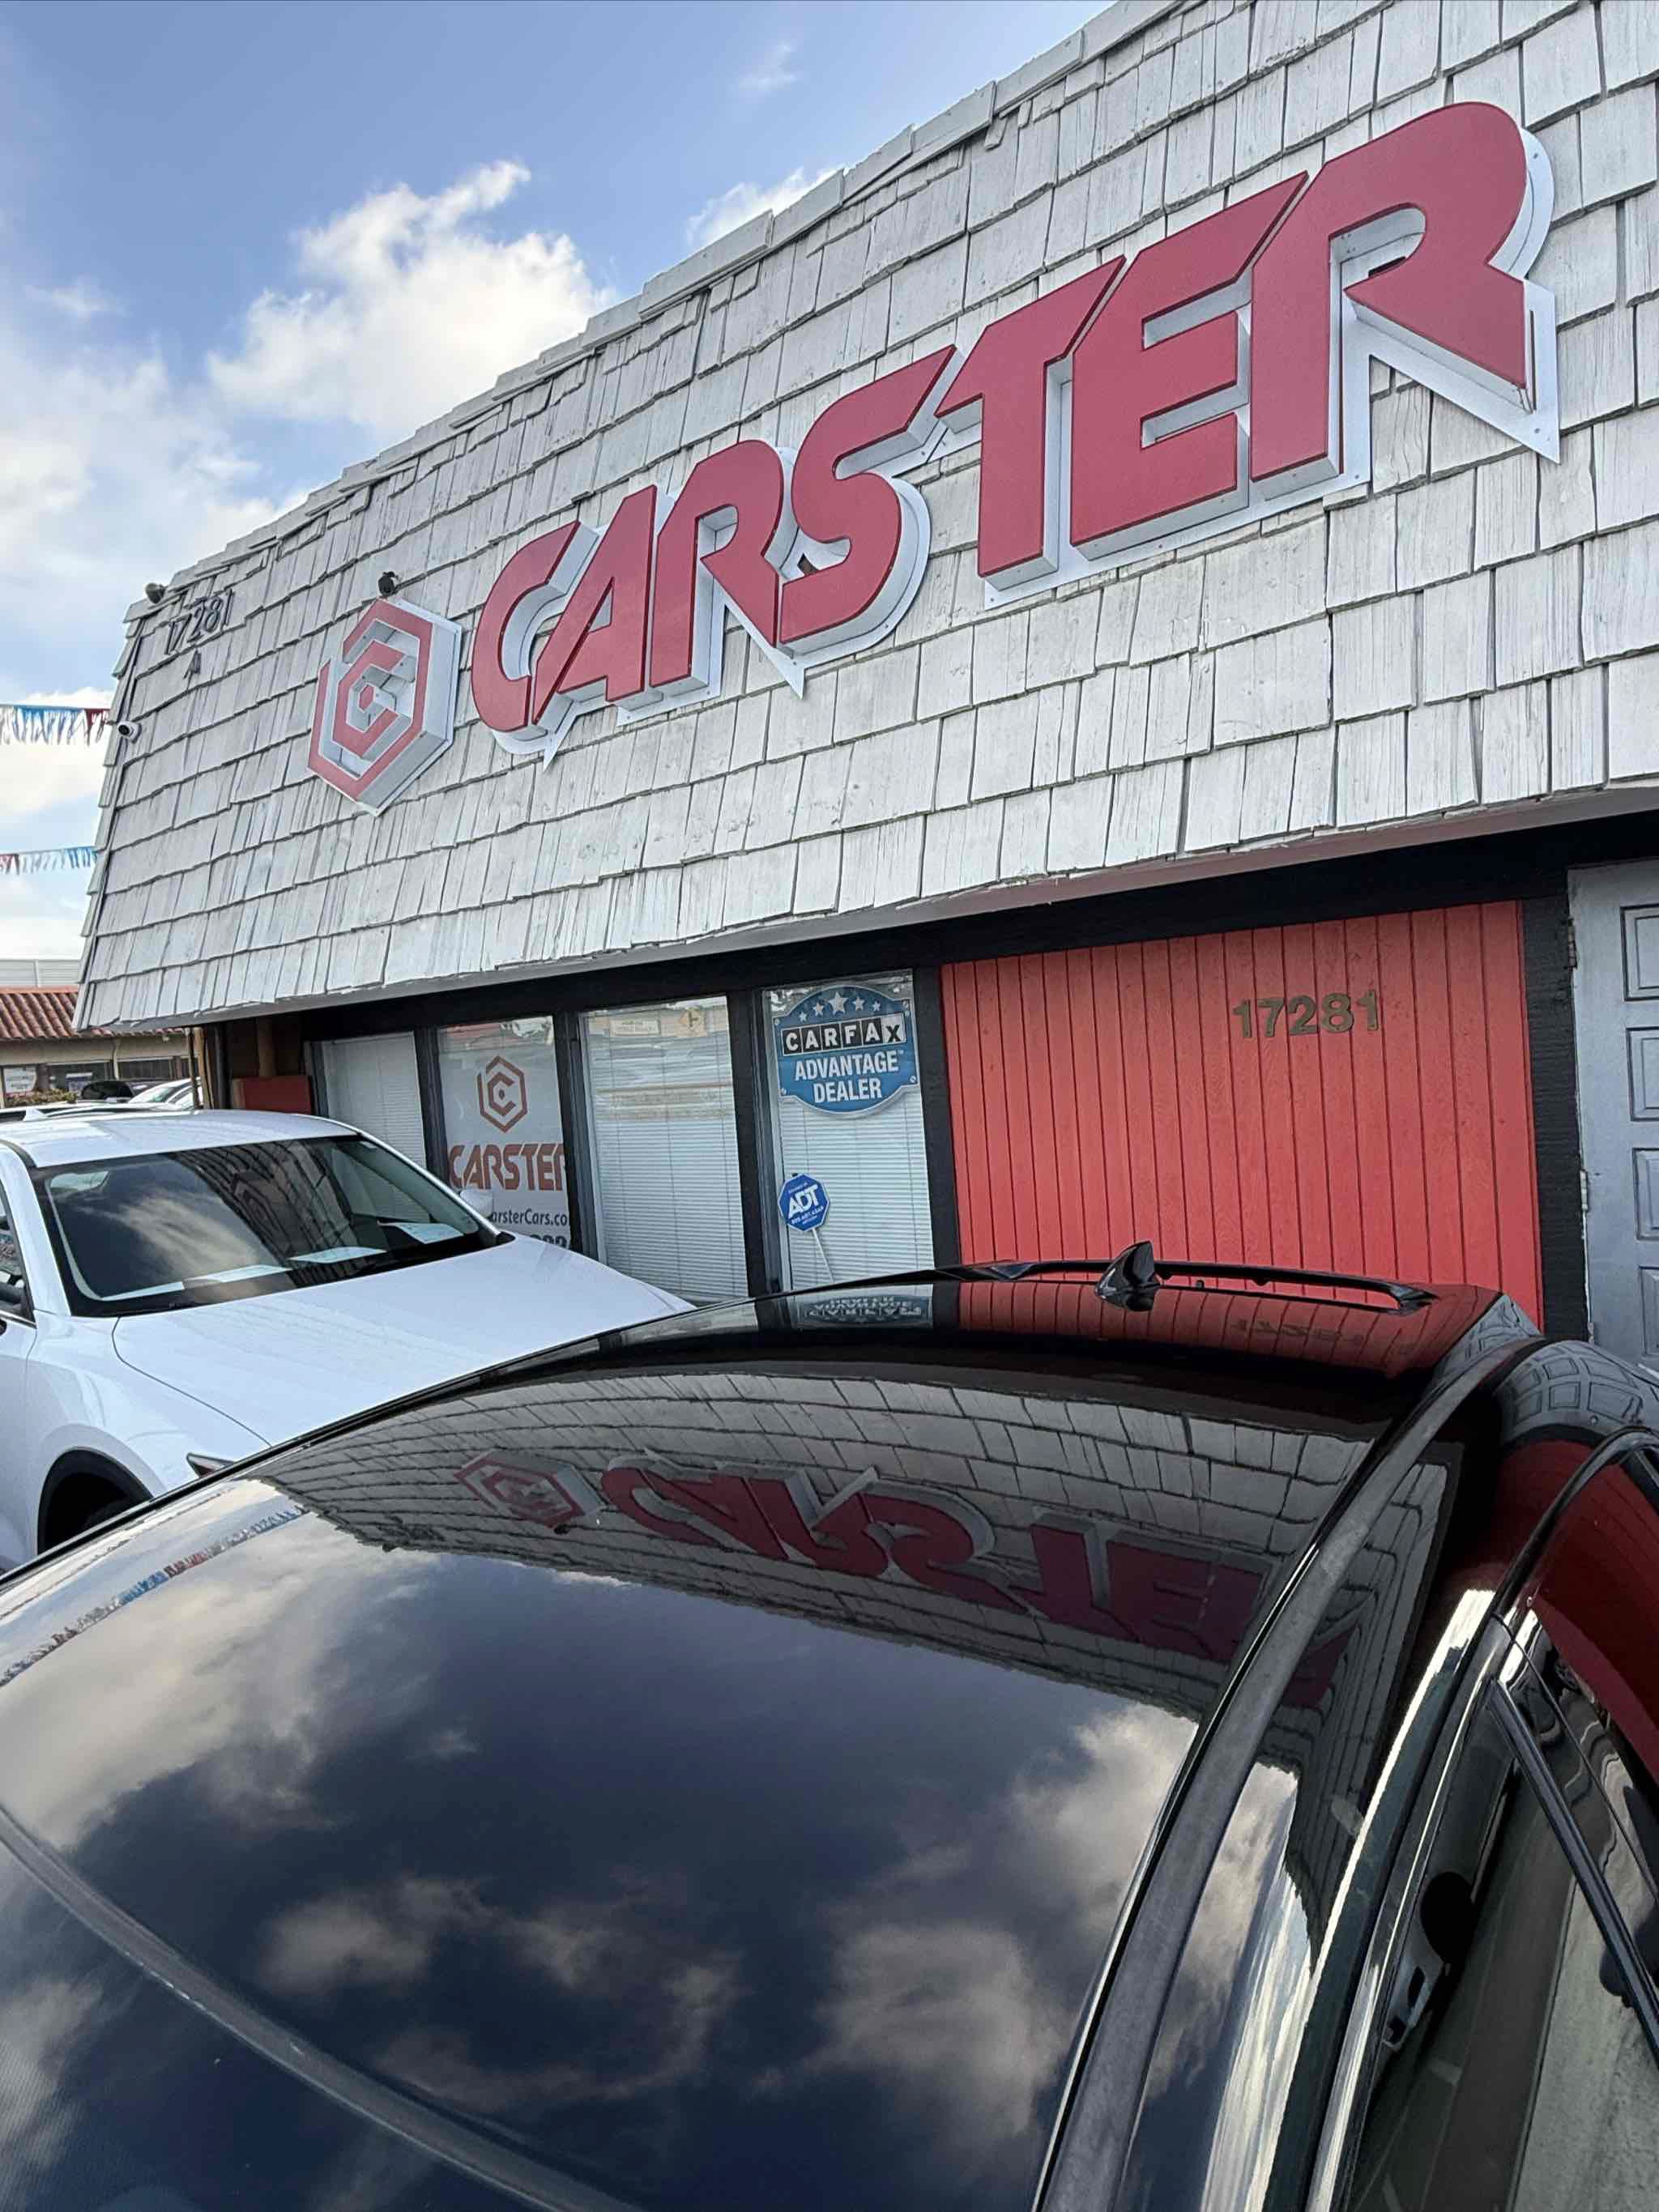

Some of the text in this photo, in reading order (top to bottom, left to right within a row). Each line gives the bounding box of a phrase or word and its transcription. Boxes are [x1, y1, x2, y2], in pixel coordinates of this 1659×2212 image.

[471, 100, 1531, 734] CARSTER
[164, 588, 236, 655] 17281
[1232, 989, 1379, 1038] 17281
[784, 1021, 902, 1052] CARFAX
[812, 1076, 882, 1104] DEALER
[787, 1183, 819, 1219] ADT
